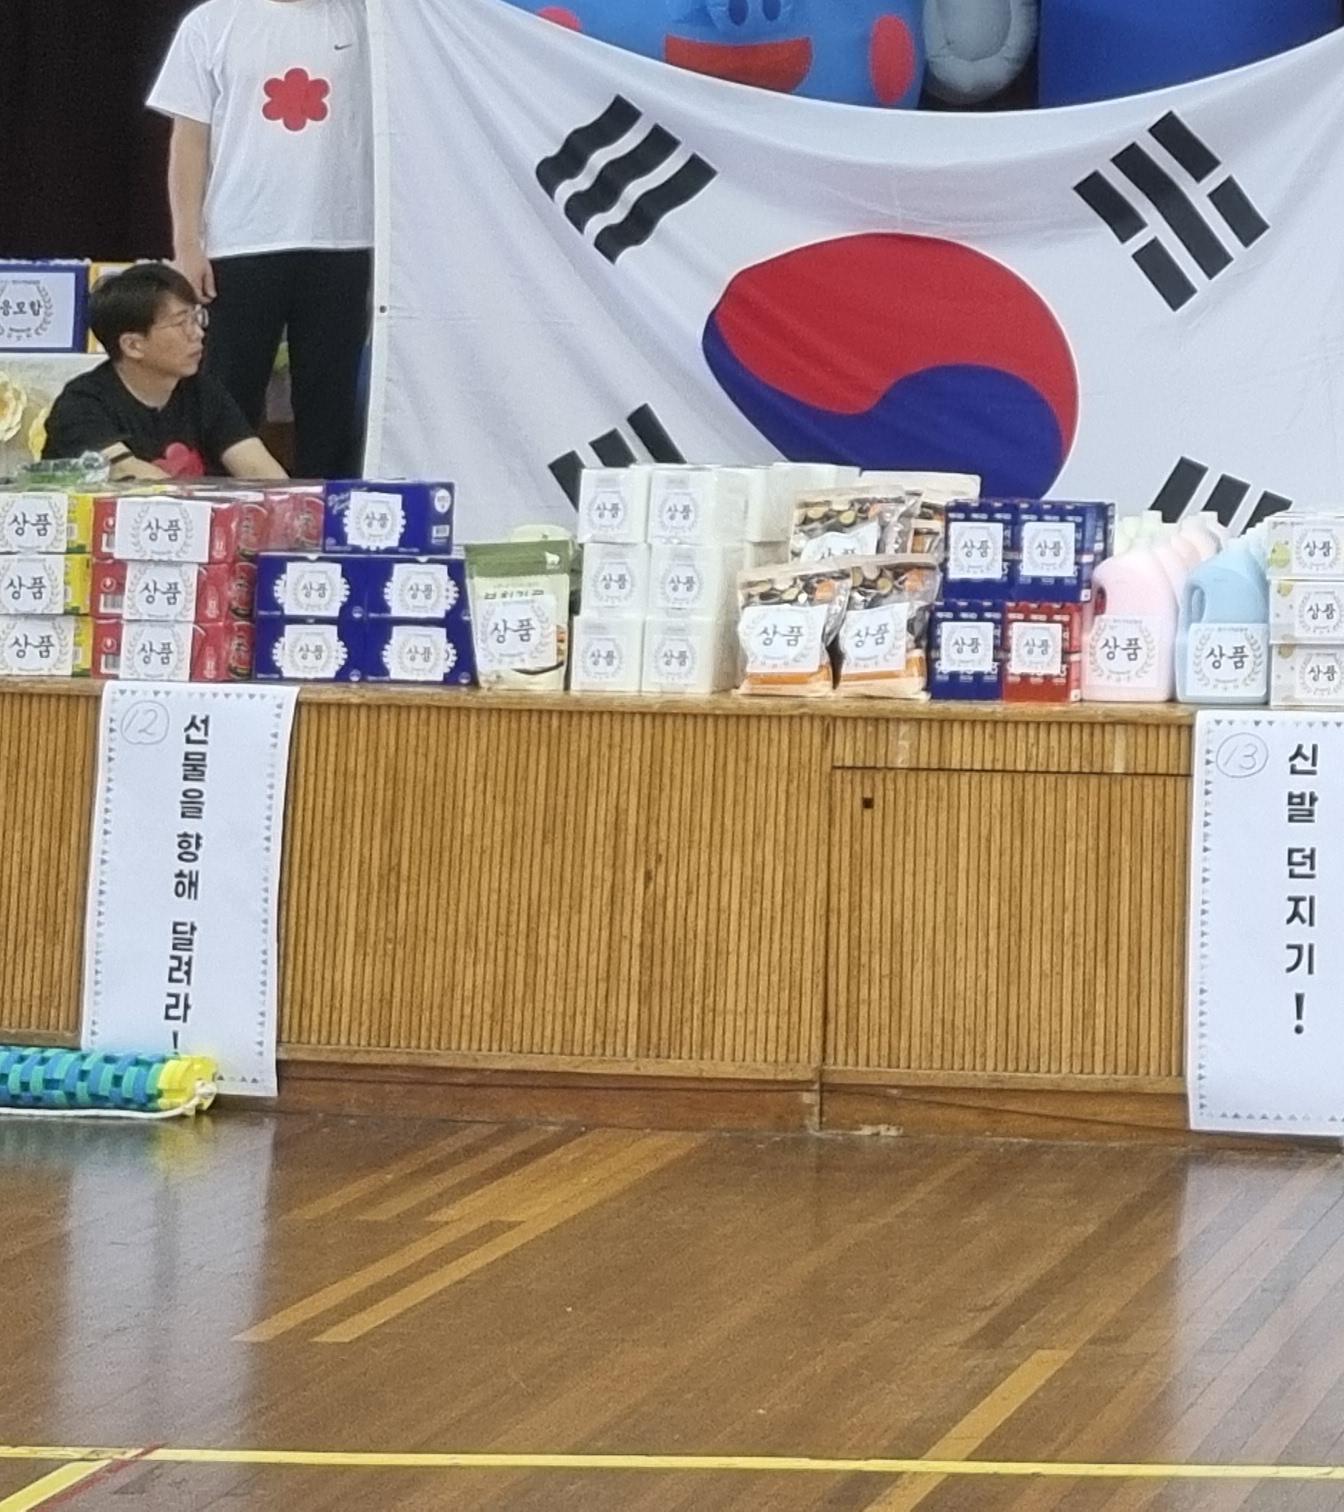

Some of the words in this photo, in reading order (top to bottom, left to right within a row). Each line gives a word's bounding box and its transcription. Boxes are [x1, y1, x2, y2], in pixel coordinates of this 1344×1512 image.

[9, 512, 51, 536] 상품
[144, 518, 181, 542] 상품
[6, 576, 46, 600] 상품
[141, 580, 181, 605] 상품
[490, 618, 535, 644] 상품
[759, 624, 803, 646] 상품
[11, 634, 55, 659] 상품
[138, 641, 173, 665] 상품
[1101, 636, 1142, 661] 상품
[1207, 645, 1249, 669] 상품
[180, 714, 211, 820] 선물을
[1287, 743, 1319, 824] 신발
[174, 831, 203, 901] 향해
[1285, 846, 1317, 1035] 던지기!
